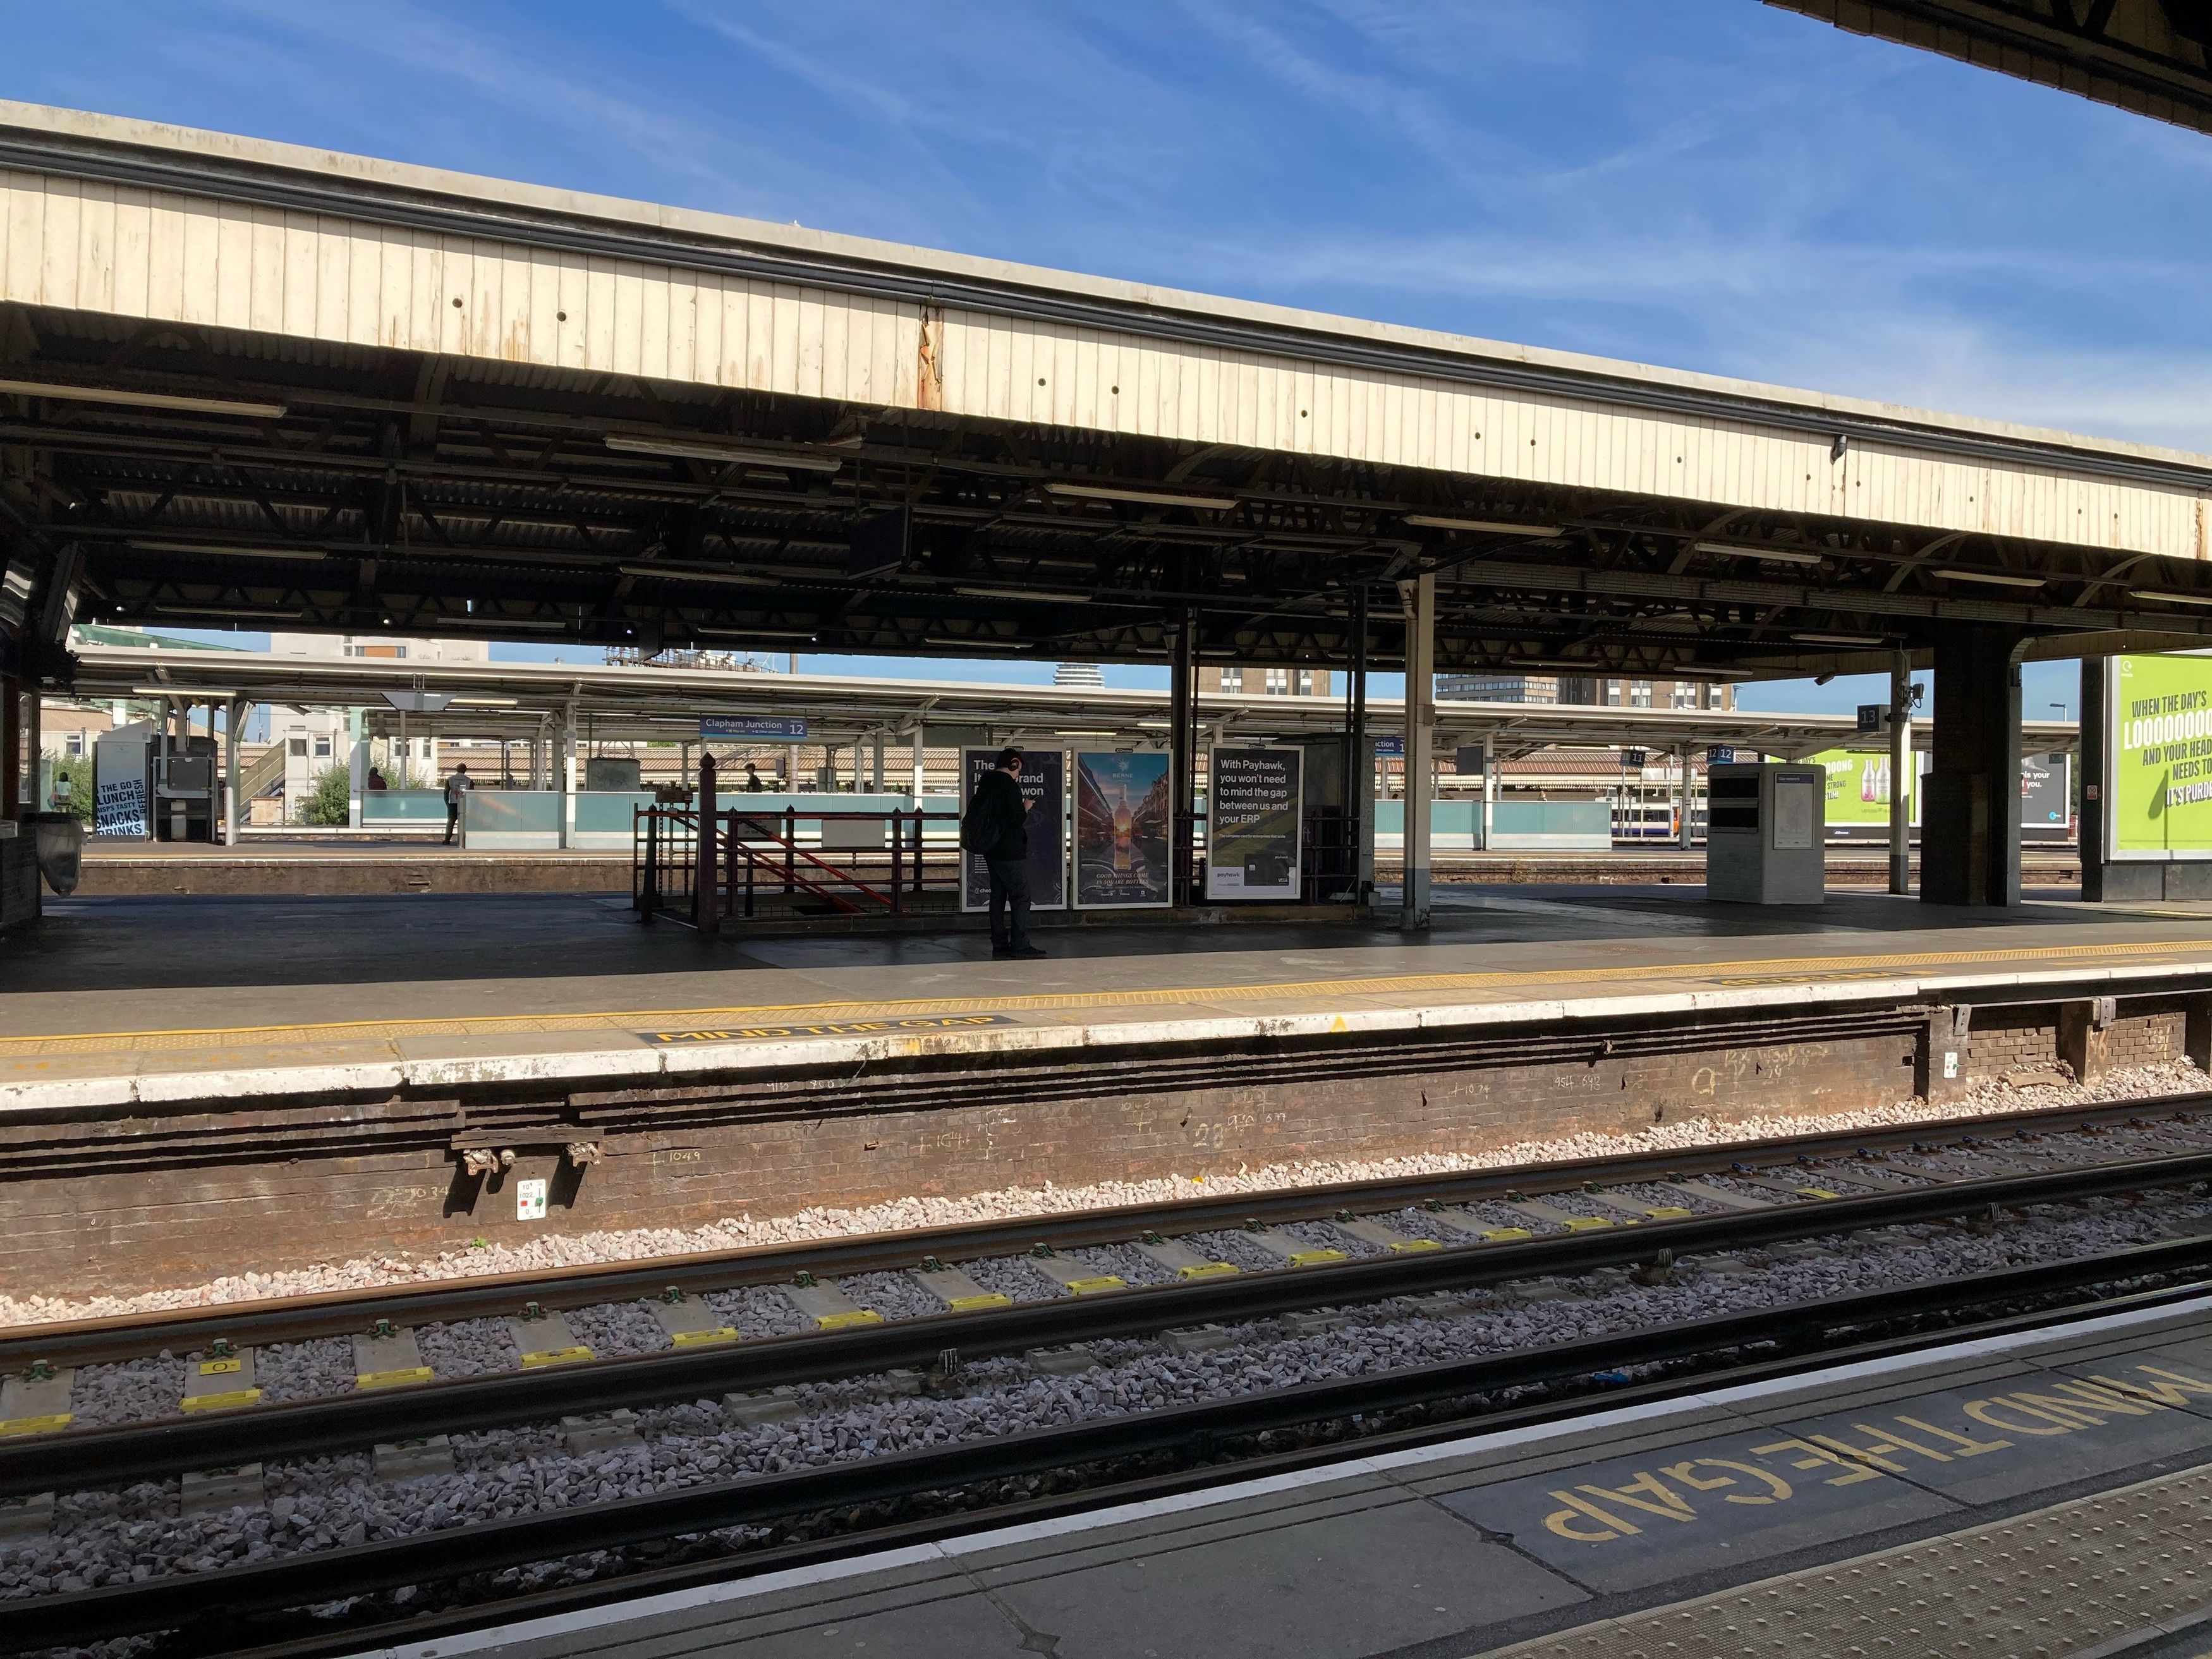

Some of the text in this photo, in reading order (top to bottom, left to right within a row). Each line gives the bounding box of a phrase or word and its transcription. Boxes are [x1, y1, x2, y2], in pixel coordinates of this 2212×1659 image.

[2132, 690, 2207, 718] WHEN THE DAY'S
[1861, 710, 1876, 724] 13
[705, 718, 782, 729] Clapham Junction
[789, 724, 804, 735] 12
[1633, 752, 1643, 763] 11
[1708, 748, 1717, 758] 12
[1720, 748, 1732, 759] 12
[2142, 738, 2212, 766] AND YOUR HEAD
[974, 760, 995, 770] The
[1220, 760, 1285, 772] With Payhawk,
[2172, 757, 2212, 781] NEEDS TO
[1239, 774, 1262, 784] won't
[1264, 775, 1286, 784] need
[1827, 780, 1846, 789] STRONG
[101, 784, 118, 793] THE
[120, 781, 131, 789] GO
[1220, 787, 1287, 799] to mind the gap
[98, 791, 135, 805] LUNCH
[2166, 786, 2184, 805] IT'S
[1219, 801, 1258, 810] between
[1272, 802, 1288, 811] and
[1219, 815, 1260, 825] your ERP
[657, 1015, 995, 1042] MIND THE GAP
[1541, 1365, 2212, 1541] MIND THE GAP
